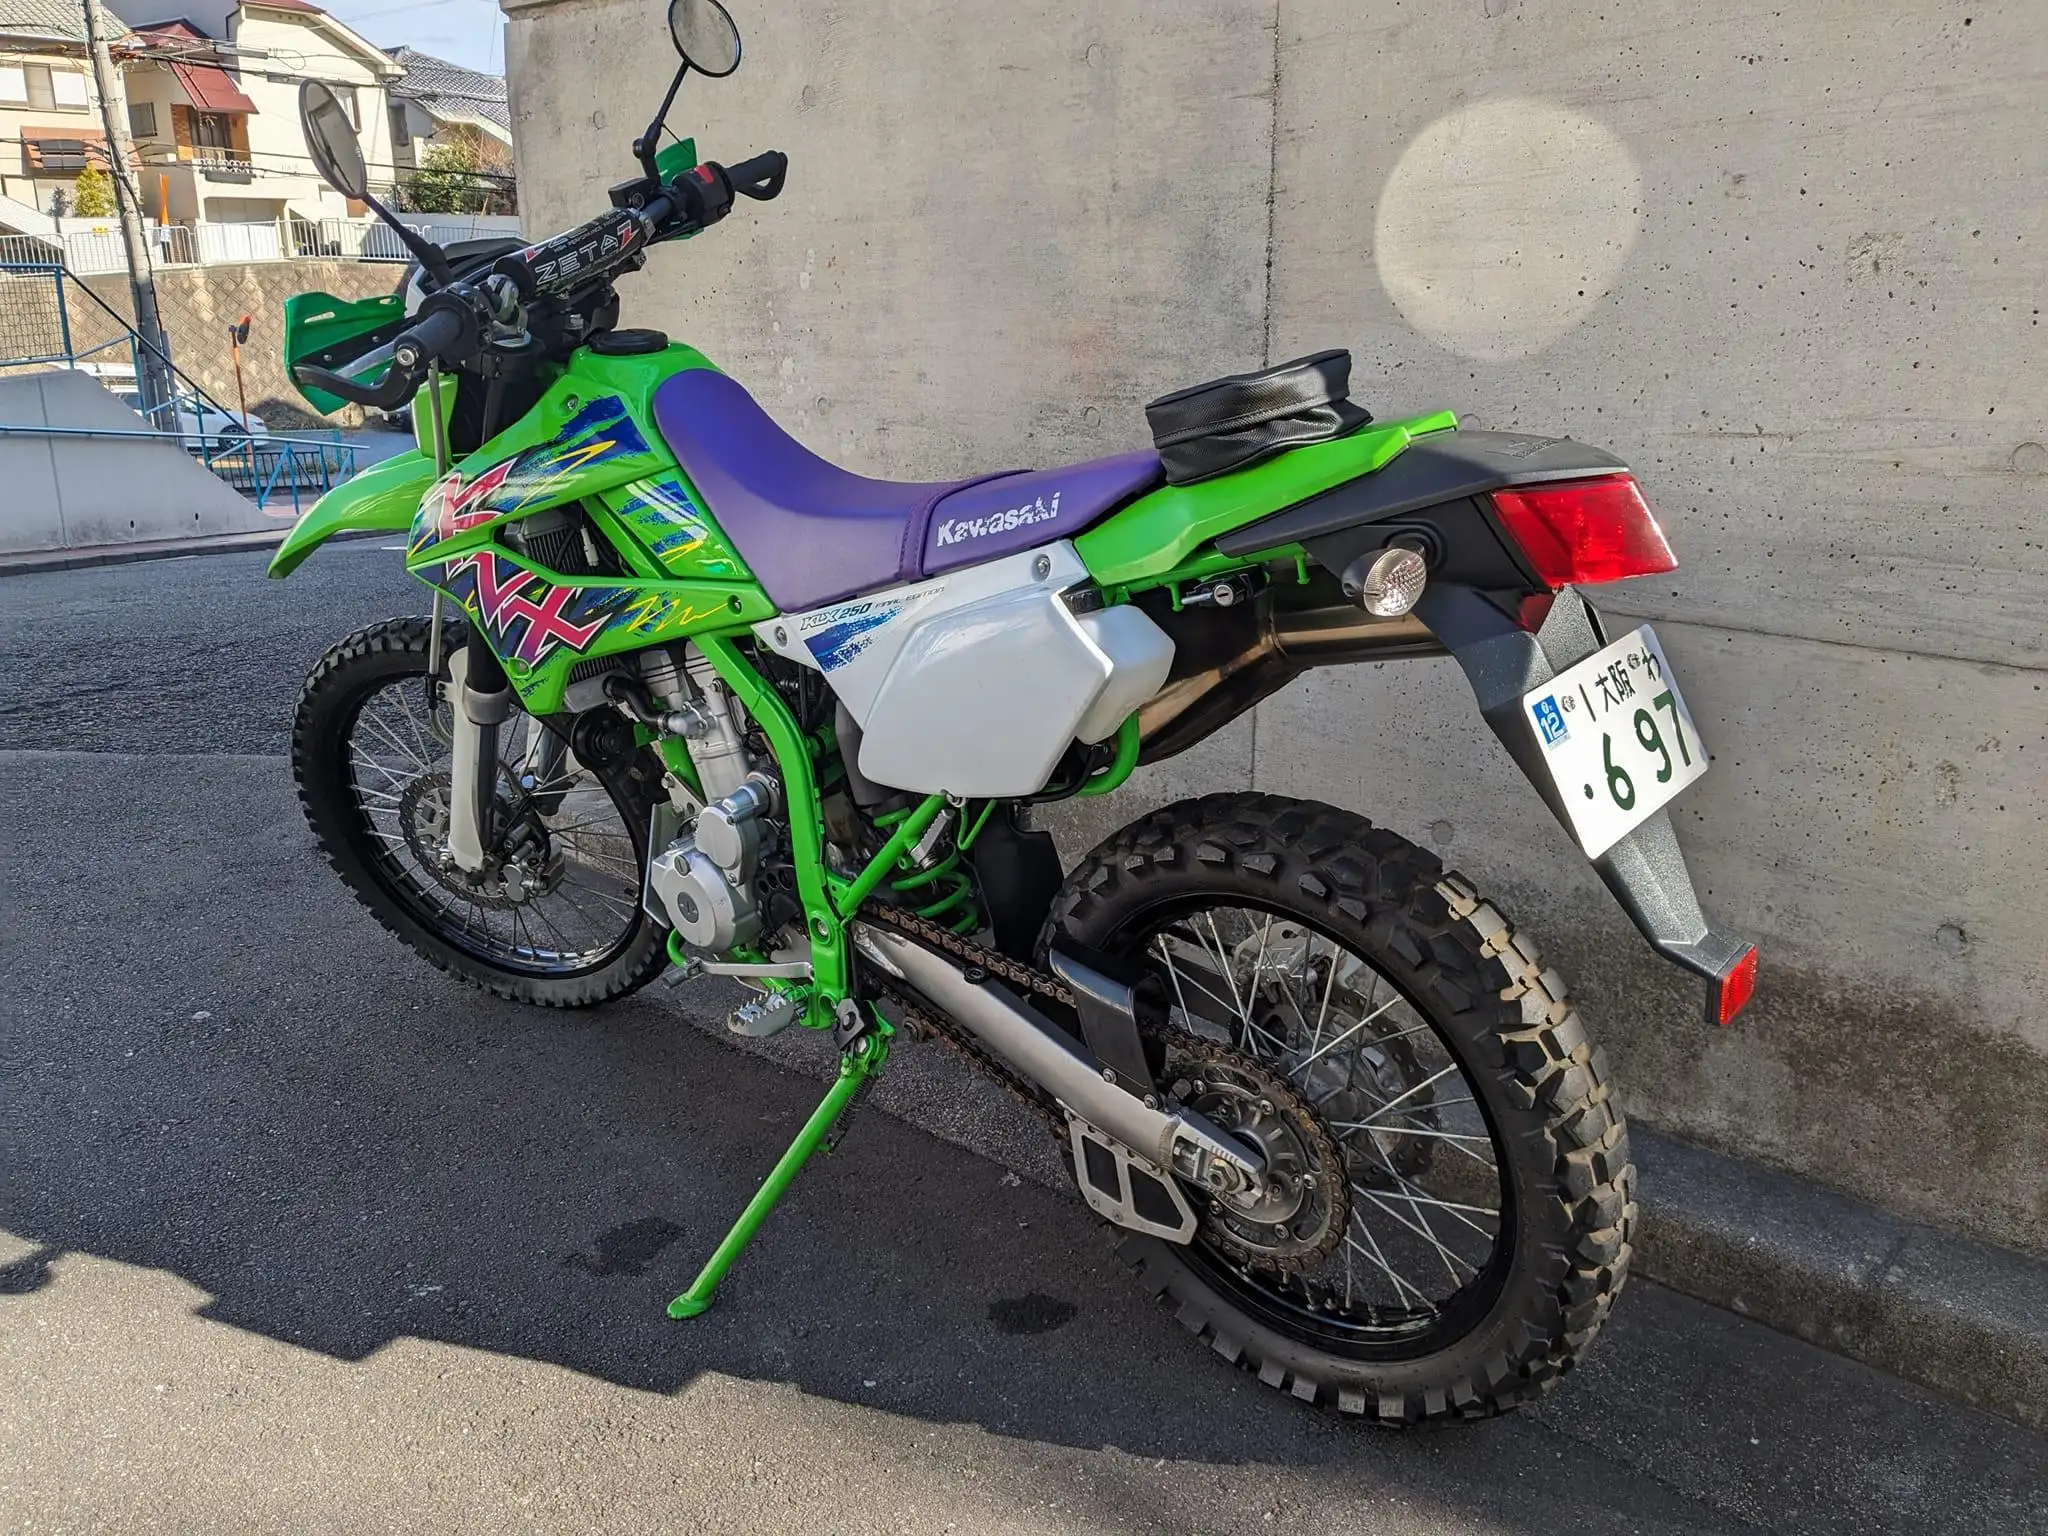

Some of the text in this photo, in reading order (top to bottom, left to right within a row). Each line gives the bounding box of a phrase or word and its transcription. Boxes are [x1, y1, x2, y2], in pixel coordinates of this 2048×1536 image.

[534, 234, 619, 286] ZETA
[936, 491, 1062, 548] Kawasaki
[905, 586, 946, 602] EDITION
[1540, 712, 1565, 741] 12
